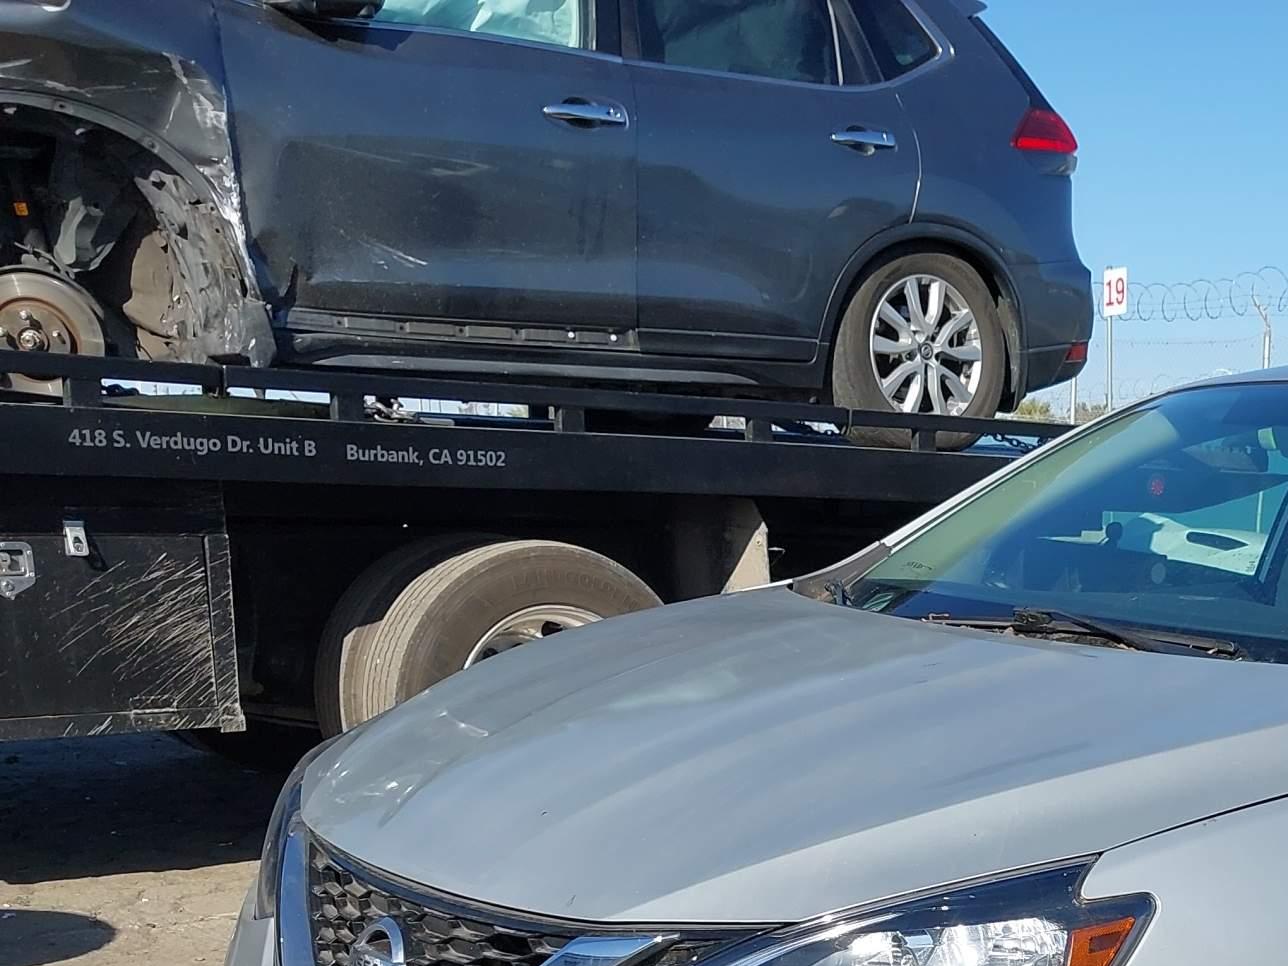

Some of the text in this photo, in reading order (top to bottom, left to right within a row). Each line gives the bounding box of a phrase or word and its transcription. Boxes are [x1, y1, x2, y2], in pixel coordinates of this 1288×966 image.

[1105, 277, 1125, 306] 19
[68, 429, 506, 467] 418 S. Verdugo Dr. Unit B Burbank, CA 91502
